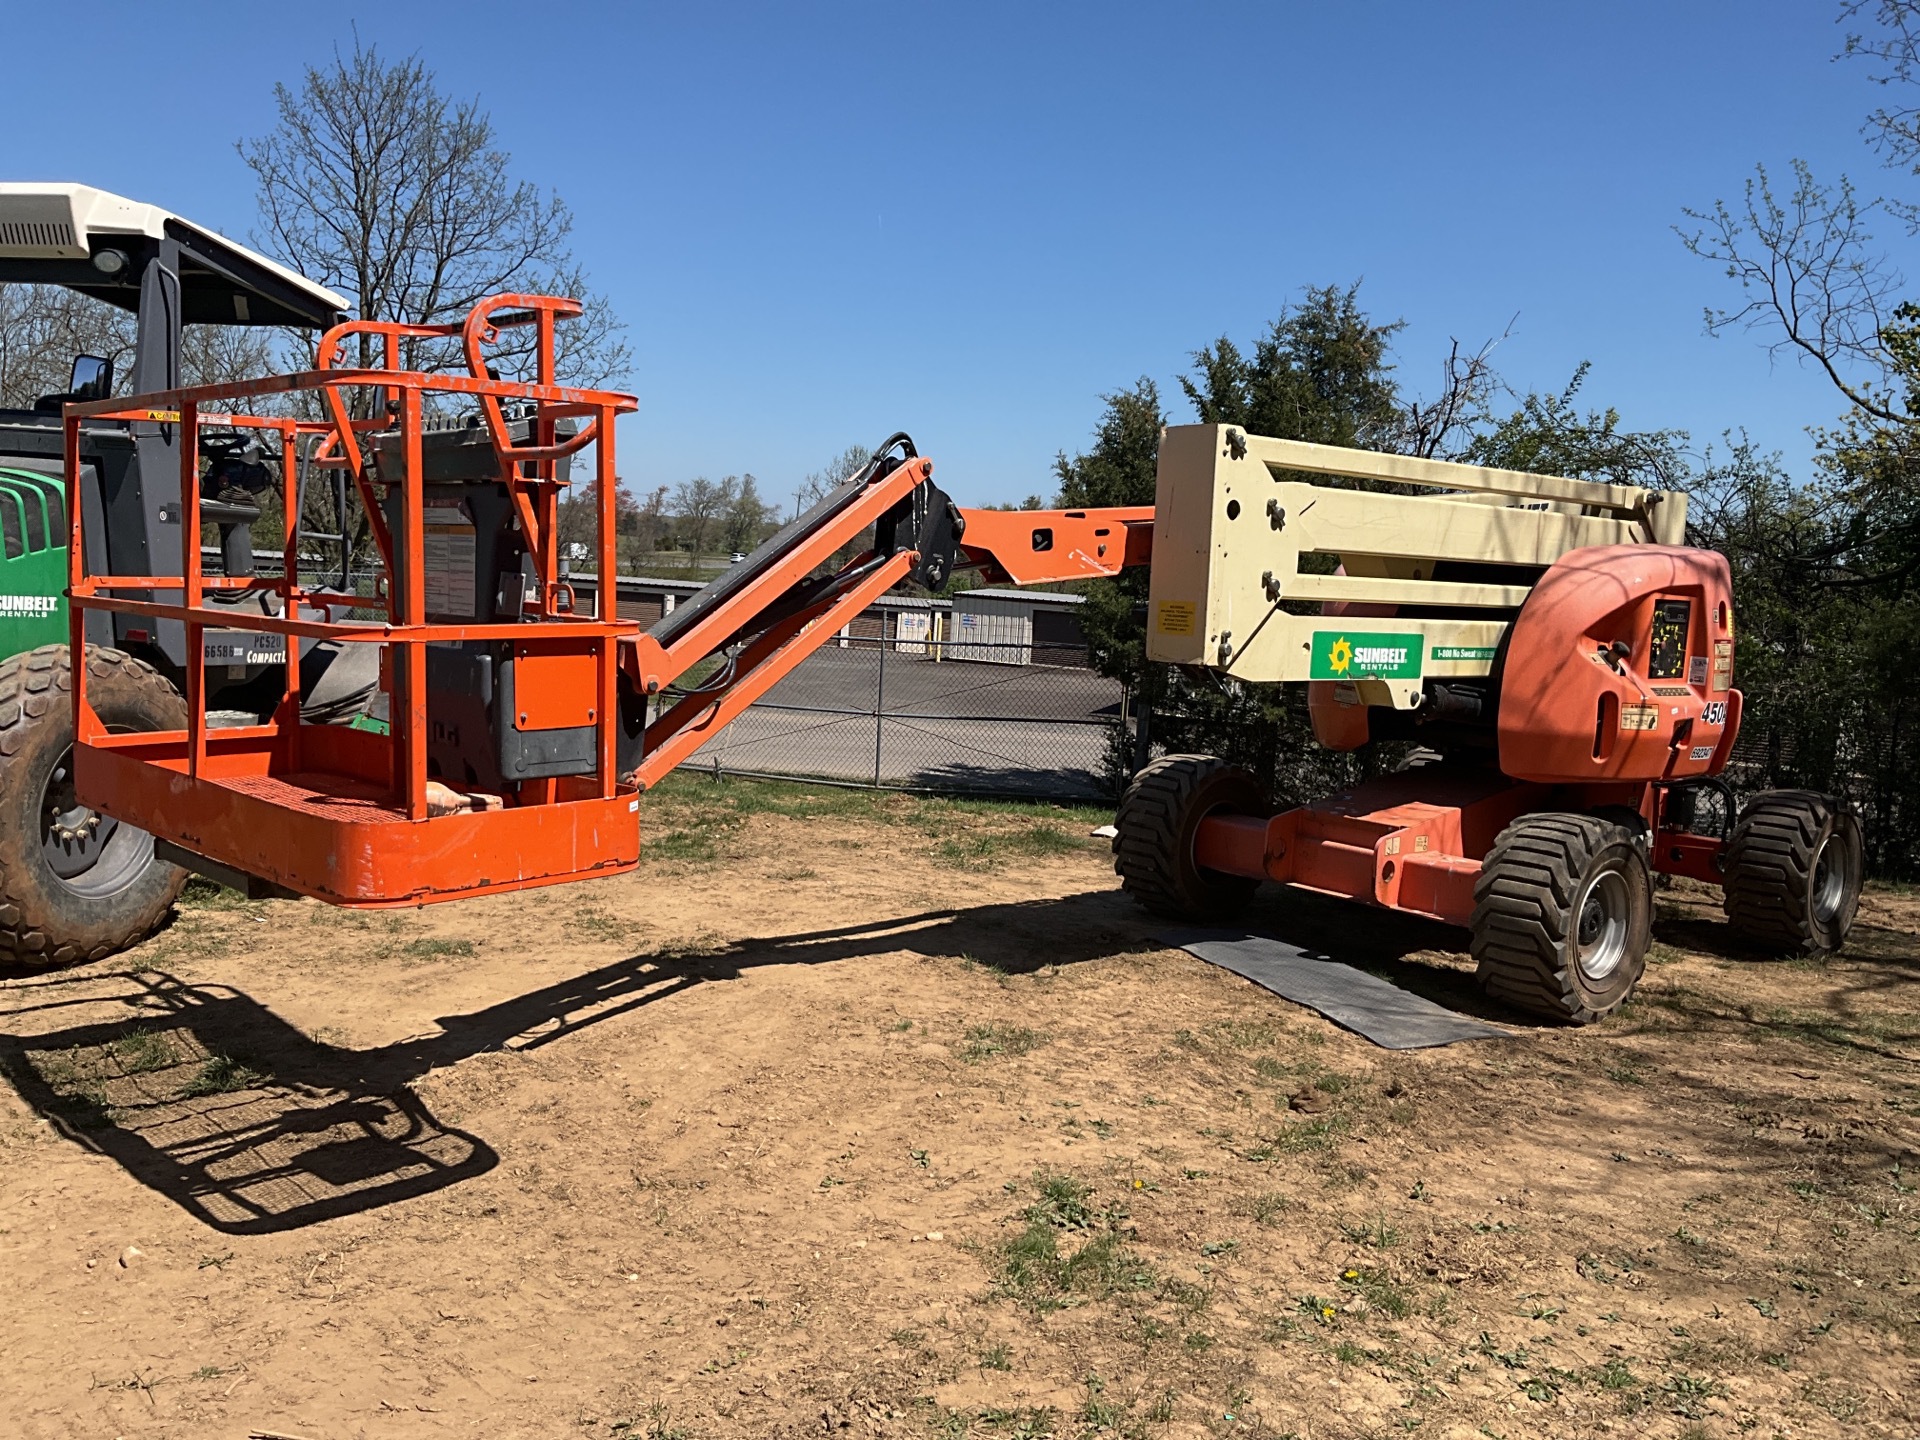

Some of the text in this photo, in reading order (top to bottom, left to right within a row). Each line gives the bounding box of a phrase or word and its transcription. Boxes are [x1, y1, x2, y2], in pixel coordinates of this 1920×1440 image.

[0, 595, 58, 611] UNBELT
[1353, 647, 1407, 663] SUNBELT
[1461, 649, 1476, 658] Sweat
